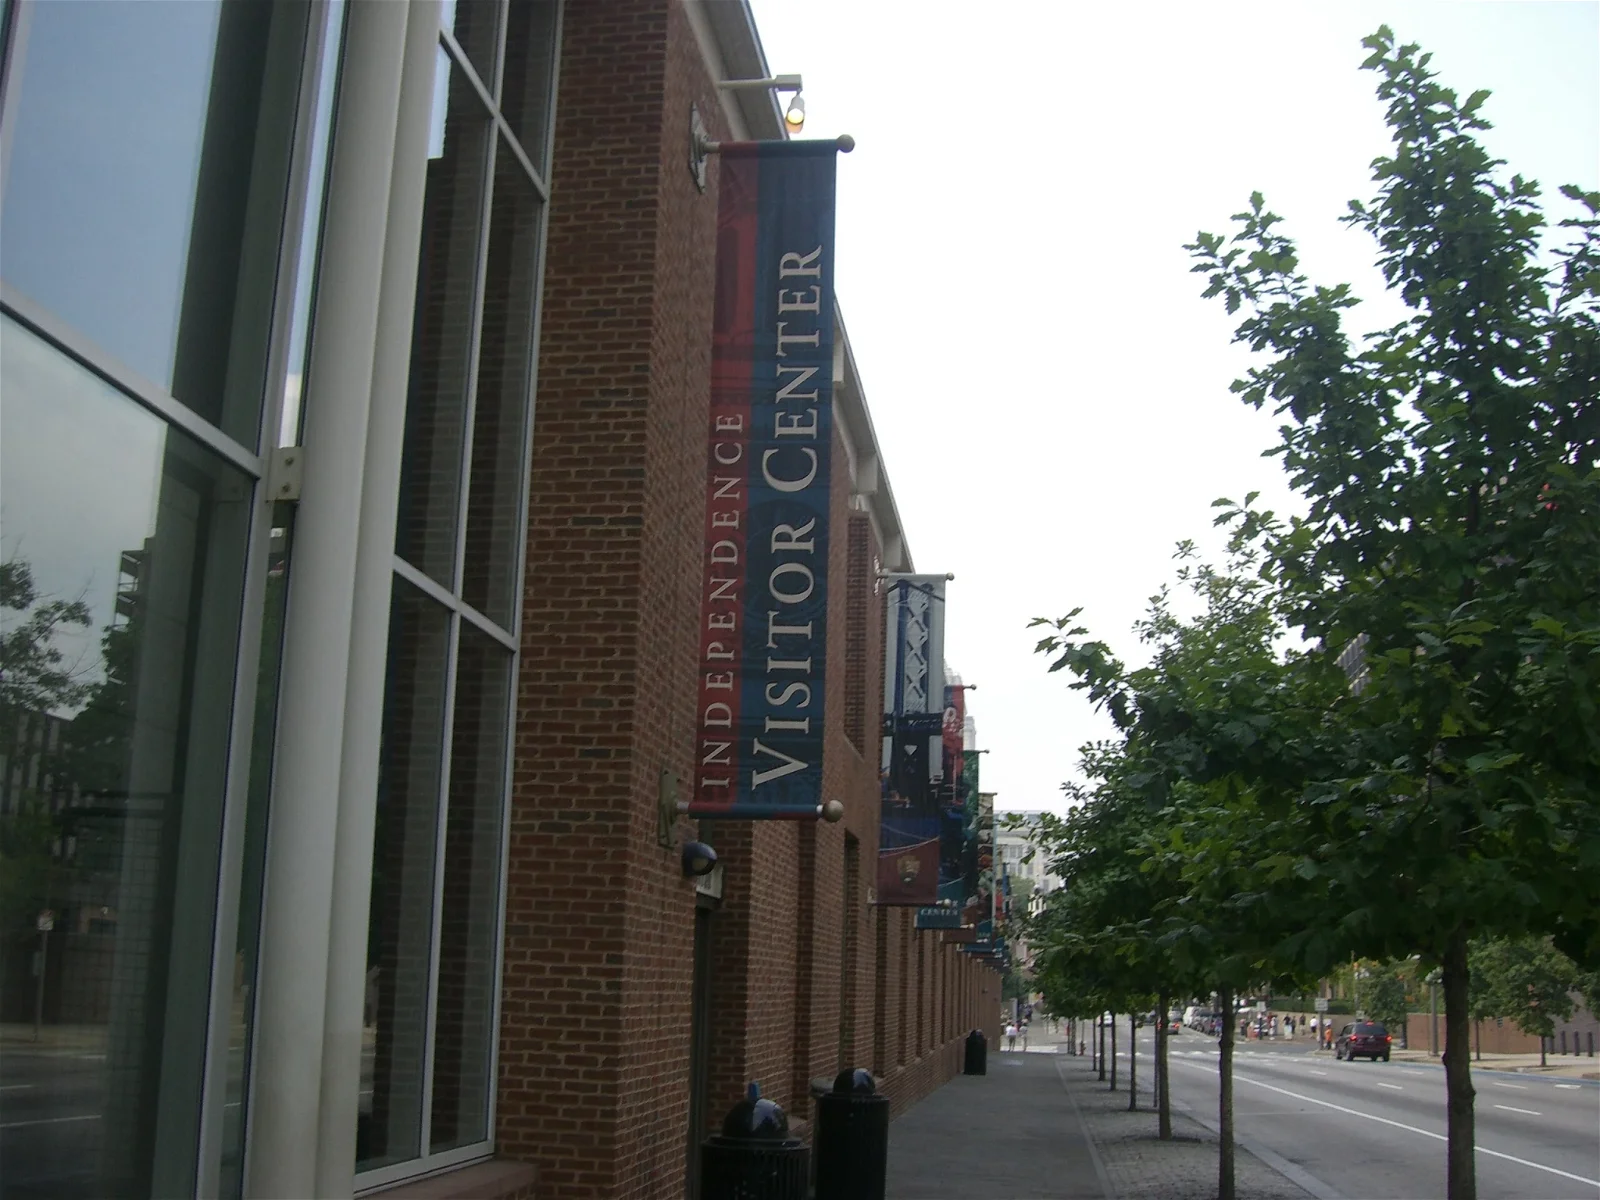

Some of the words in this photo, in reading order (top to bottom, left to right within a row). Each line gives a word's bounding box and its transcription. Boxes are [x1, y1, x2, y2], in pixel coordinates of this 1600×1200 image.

[761, 244, 823, 493] CENTER
[701, 413, 743, 789] INDEPENDENCE
[751, 517, 816, 791] VISITOR
